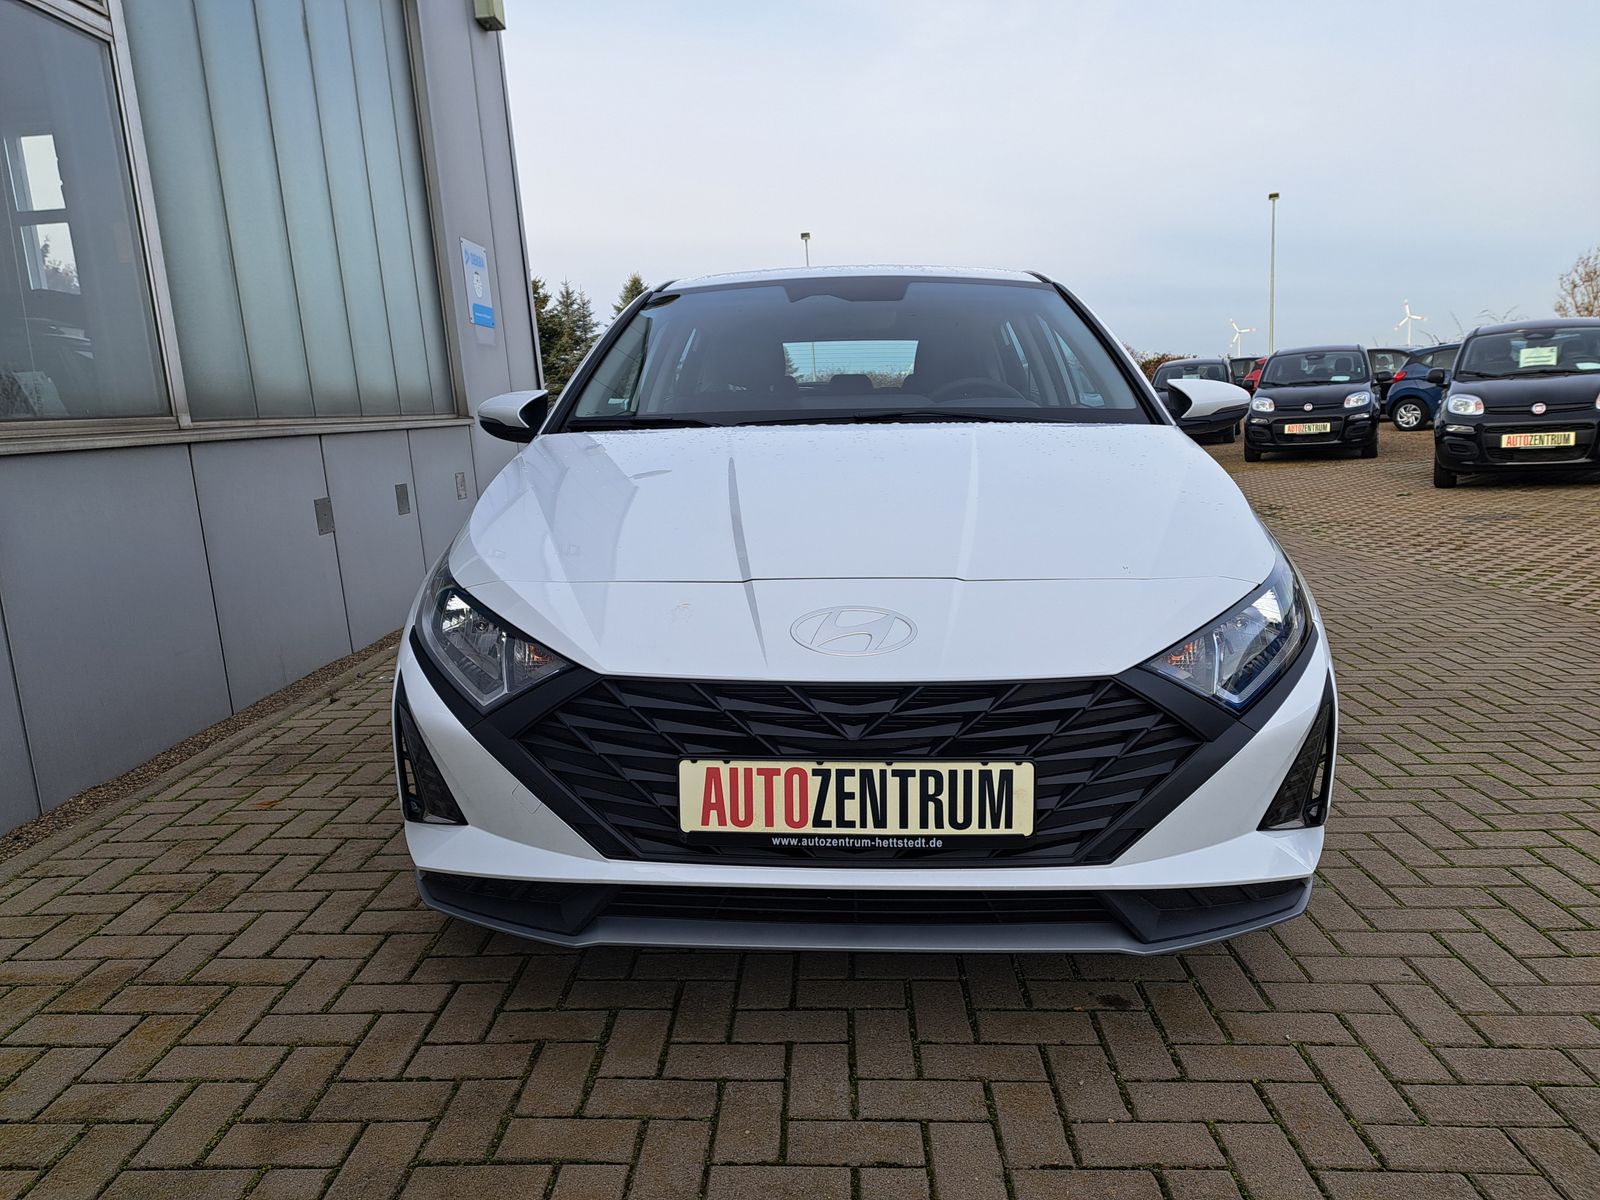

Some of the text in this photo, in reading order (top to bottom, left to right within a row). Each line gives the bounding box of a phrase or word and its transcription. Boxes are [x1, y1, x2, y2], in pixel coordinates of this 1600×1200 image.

[1506, 433, 1570, 447] AUTOZENTRUM
[700, 767, 1014, 830] AUTOZENTRUM
[772, 836, 943, 849] www.autozentrum-hettstedt.de
